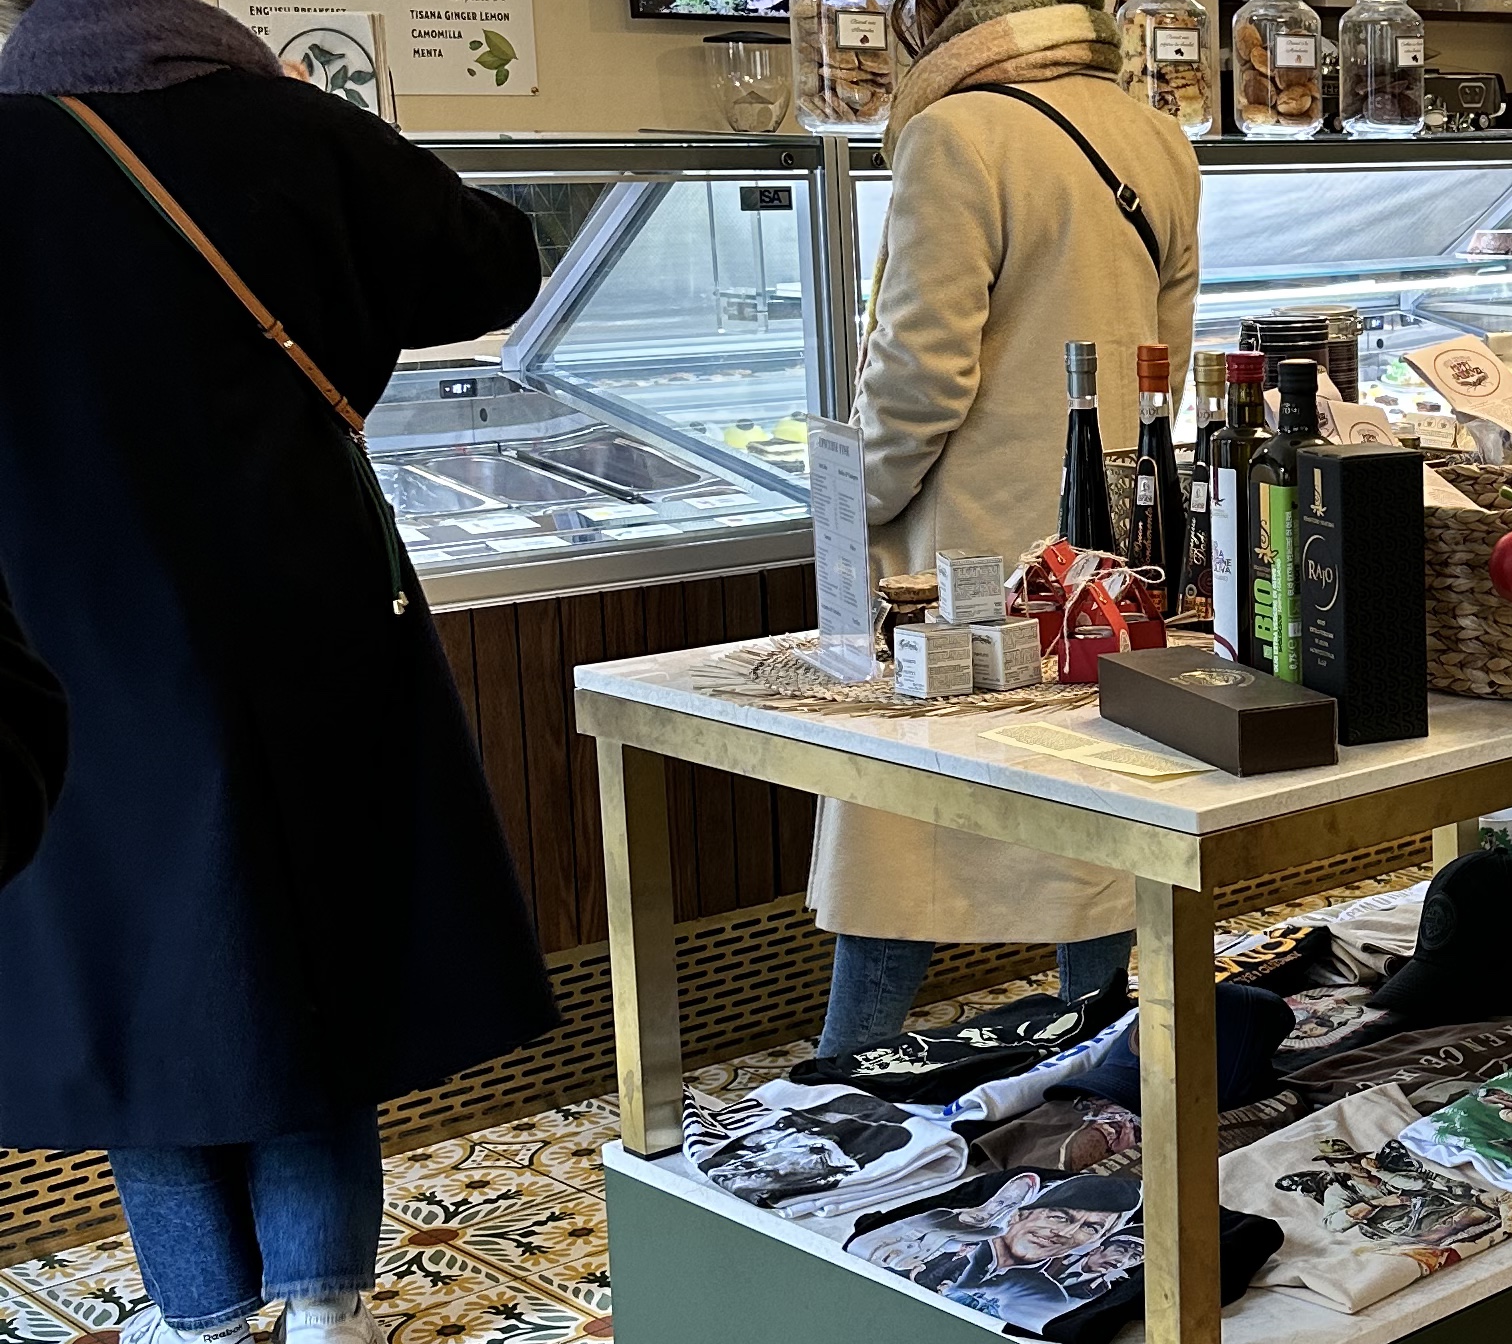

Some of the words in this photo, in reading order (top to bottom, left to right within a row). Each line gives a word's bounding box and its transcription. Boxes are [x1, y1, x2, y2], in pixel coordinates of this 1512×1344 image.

[410, 9, 442, 21] TISANA
[444, 10, 478, 22] GINGER
[480, 11, 510, 22] LEMON
[411, 29, 463, 40] CAMOMILLA
[413, 47, 444, 59] MENTA
[759, 189, 783, 204] ISA
[1307, 559, 1334, 590] RAJO
[1254, 578, 1273, 642] BIO
